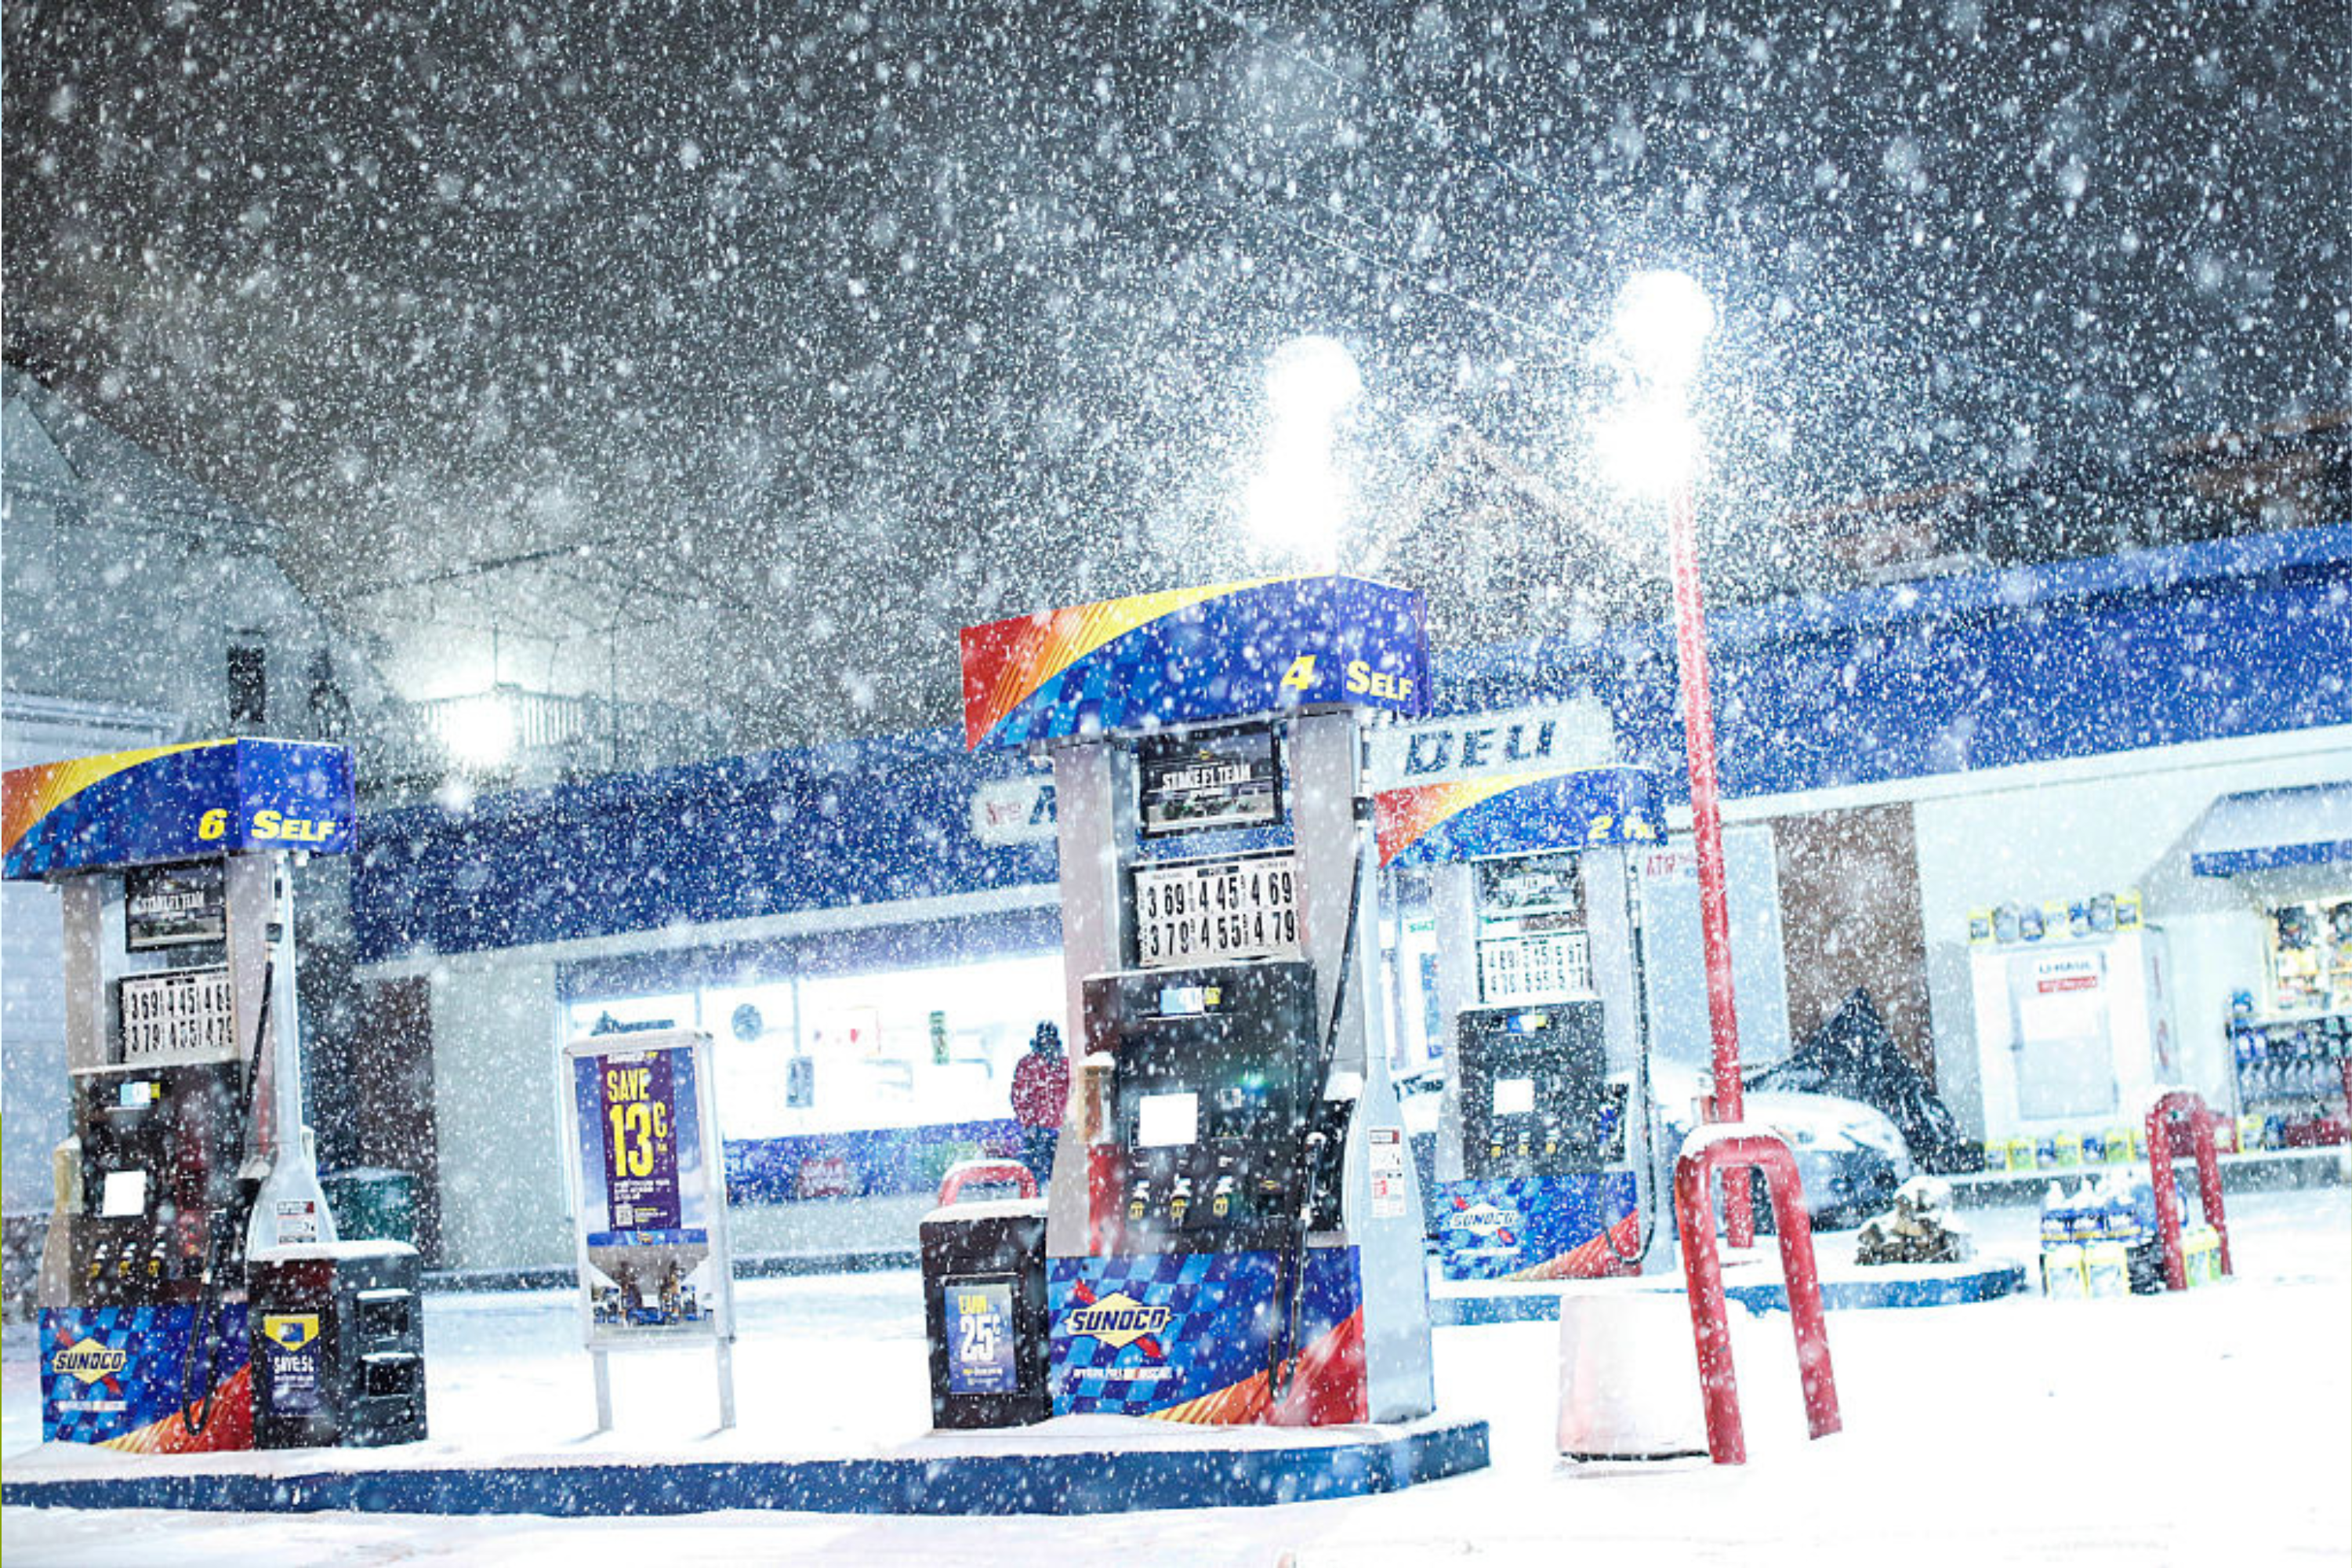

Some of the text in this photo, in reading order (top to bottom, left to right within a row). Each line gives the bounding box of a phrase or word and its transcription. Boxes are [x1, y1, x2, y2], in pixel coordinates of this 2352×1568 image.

[1280, 654, 1414, 701] 4 SELF
[1403, 720, 1556, 776] DELI
[198, 808, 336, 842] 6 SELF
[1587, 815, 1613, 840] 2
[607, 1067, 650, 1102] SAVE
[1073, 1308, 1167, 1331] SUNOCO
[56, 1352, 124, 1370] SUNOCO
